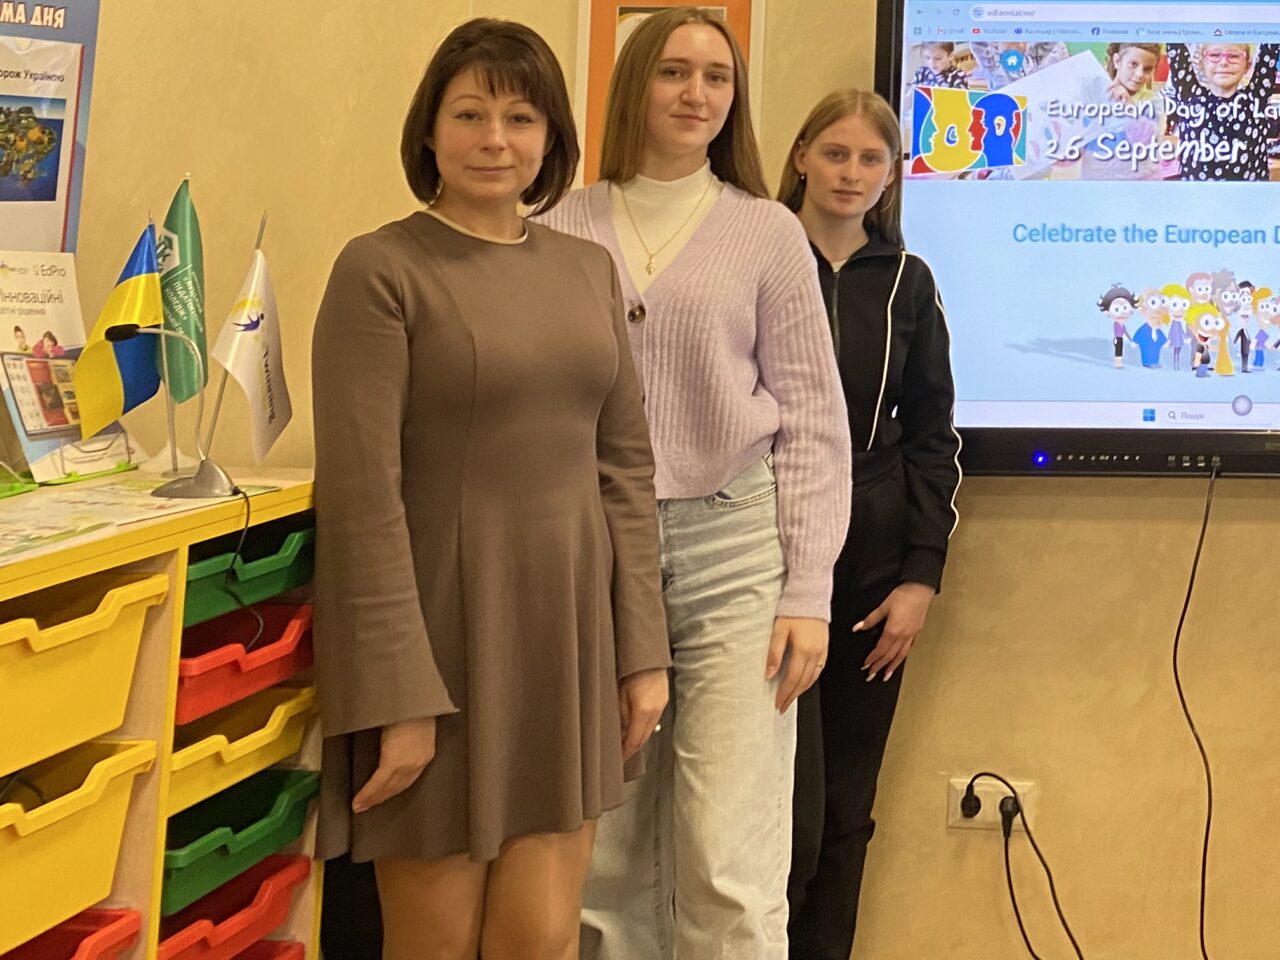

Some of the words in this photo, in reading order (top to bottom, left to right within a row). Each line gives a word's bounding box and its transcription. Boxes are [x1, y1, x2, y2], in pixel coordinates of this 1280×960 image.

[29, 4, 67, 29] ДНЯ
[1046, 100, 1154, 125] European
[1165, 100, 1206, 127] Day
[1216, 94, 1247, 119] of
[1045, 135, 1081, 161] 26
[1093, 128, 1247, 172] September
[1012, 223, 1117, 243] Celebrate
[1123, 223, 1158, 243] the
[1165, 224, 1267, 248] European
